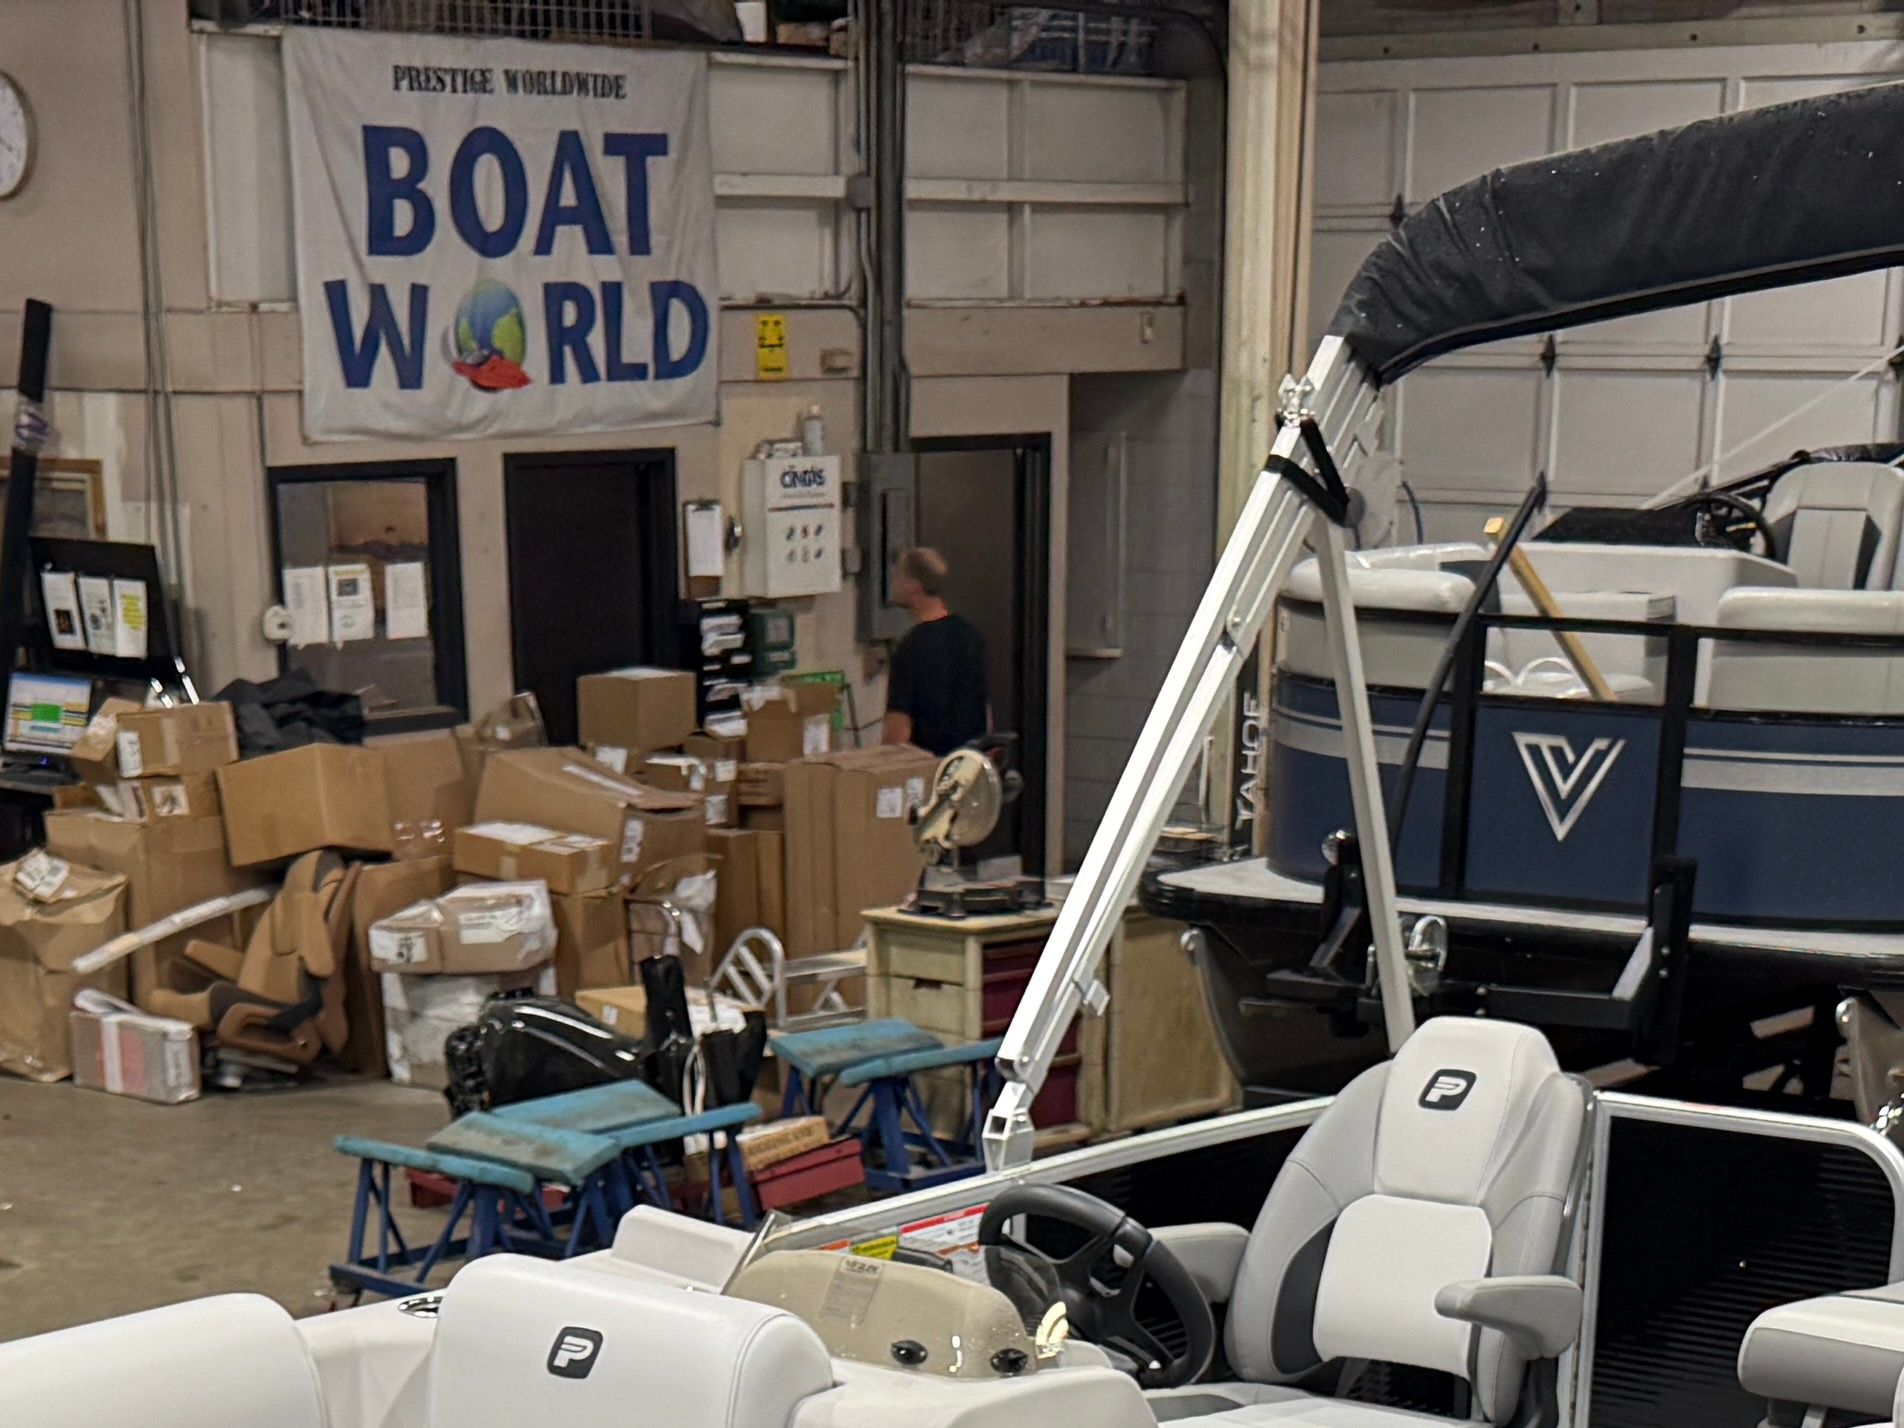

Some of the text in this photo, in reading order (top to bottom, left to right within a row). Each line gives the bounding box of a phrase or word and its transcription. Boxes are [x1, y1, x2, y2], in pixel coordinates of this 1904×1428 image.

[393, 64, 627, 99] PRESTIGE WORLDWIDE
[362, 124, 668, 258] BOAT
